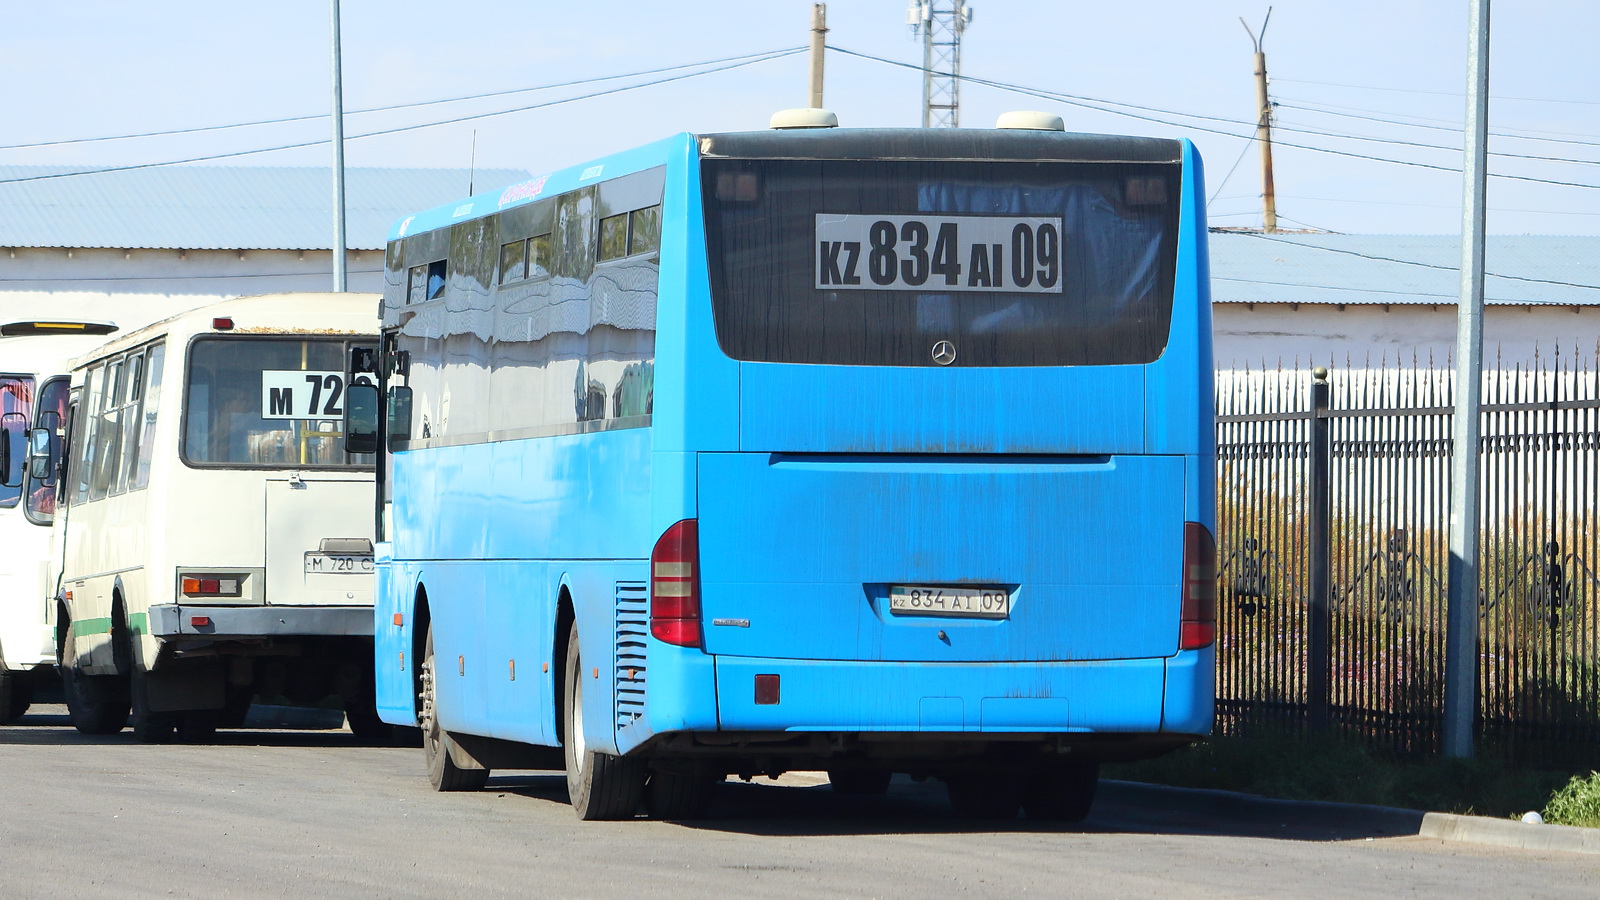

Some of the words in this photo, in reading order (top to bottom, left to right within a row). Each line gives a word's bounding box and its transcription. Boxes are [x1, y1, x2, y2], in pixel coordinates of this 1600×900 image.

[820, 241, 861, 285] KZ
[868, 220, 962, 286] 834
[967, 243, 1003, 288] AI
[1011, 222, 1059, 288] 09
[269, 387, 293, 416] M
[305, 374, 372, 416] 72
[312, 557, 323, 570] M
[330, 557, 354, 571] 720
[893, 599, 906, 608] KZ
[910, 589, 946, 609] 834
[951, 594, 972, 610] AI
[982, 592, 1005, 611] 09
